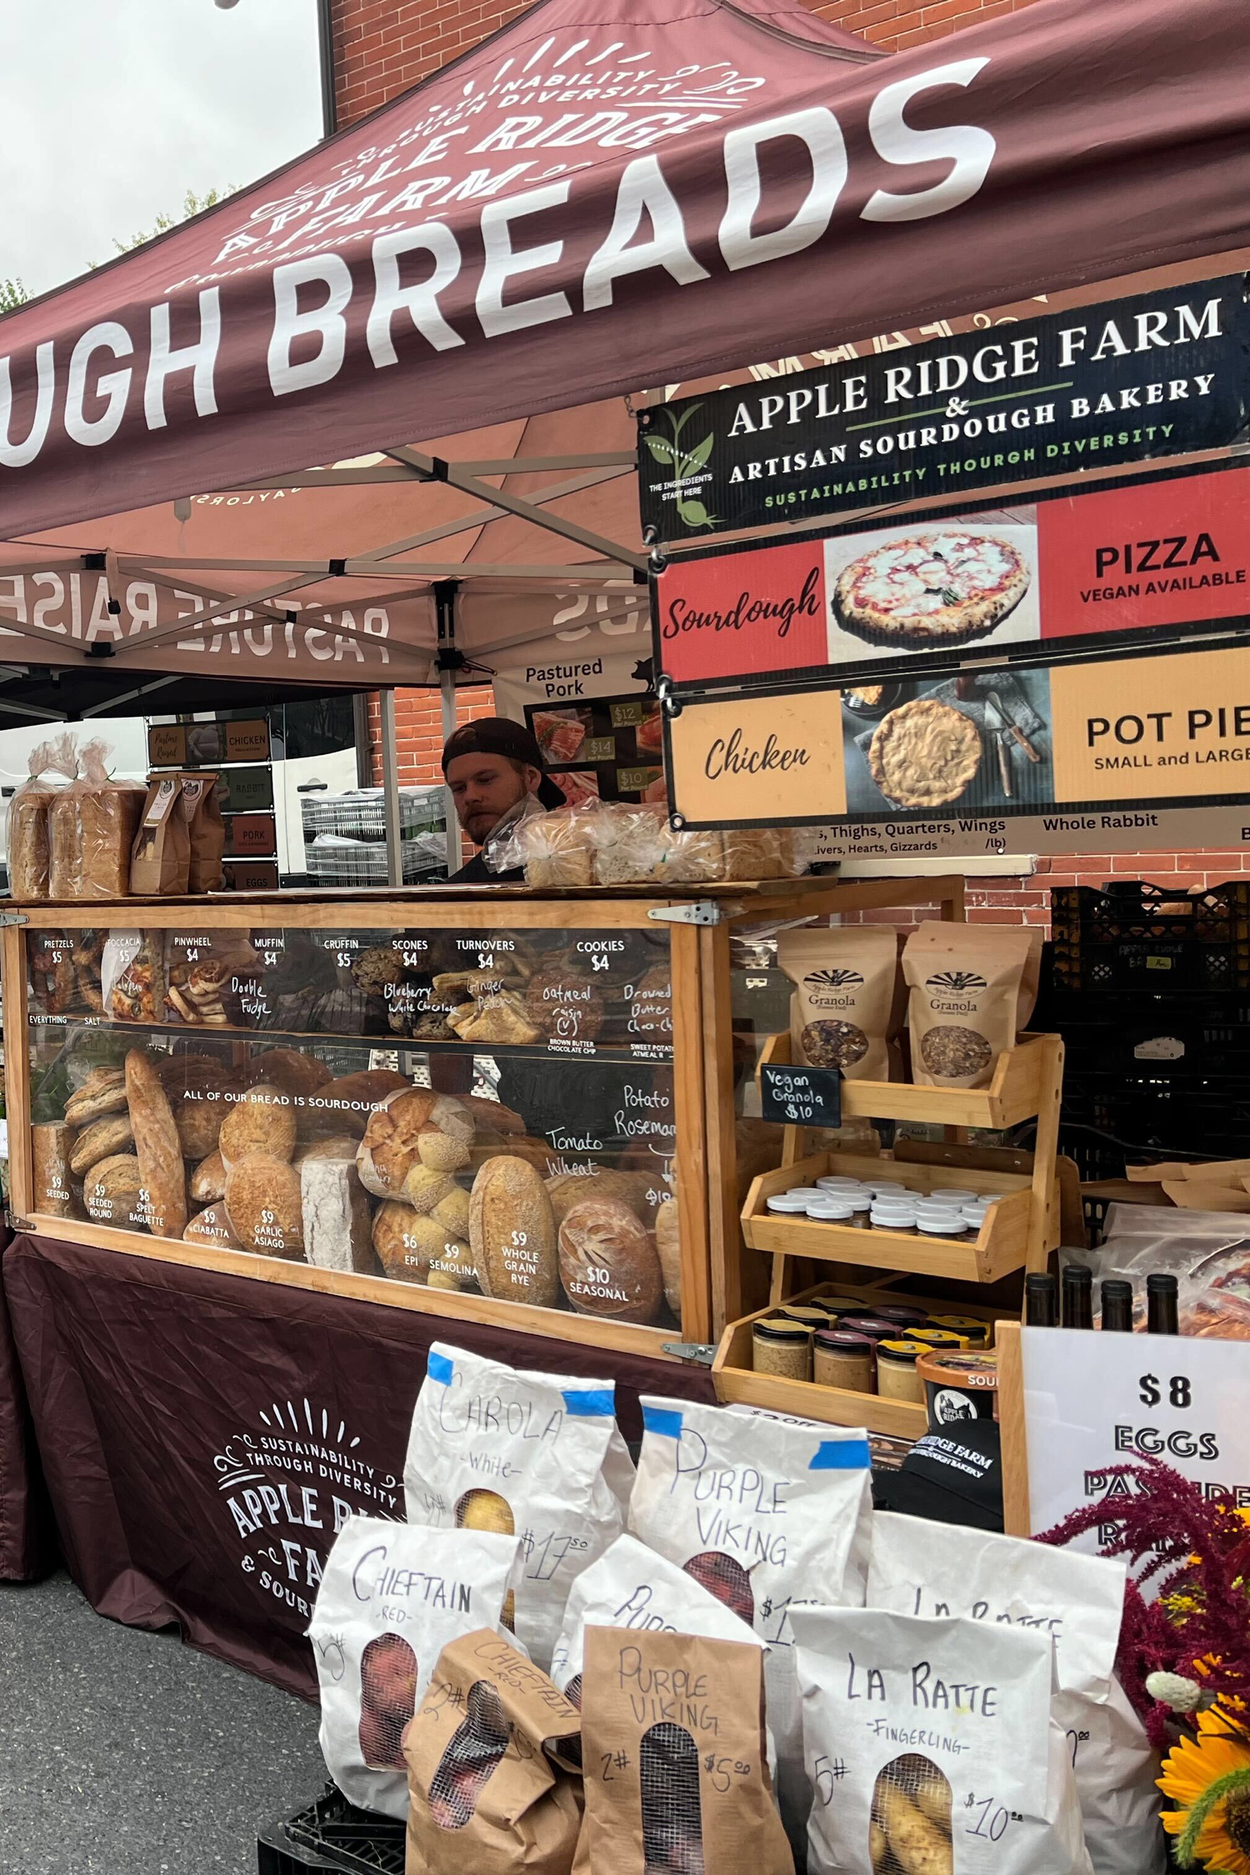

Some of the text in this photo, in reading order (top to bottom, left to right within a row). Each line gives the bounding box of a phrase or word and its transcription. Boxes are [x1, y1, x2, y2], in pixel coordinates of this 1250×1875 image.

[498, 82, 682, 108] DIVERSITY
[211, 126, 470, 266] APPLE
[268, 160, 539, 254] FARM
[266, 56, 997, 396] BREADS
[727, 374, 868, 437] APPLE
[883, 337, 1040, 404] RIDGE
[1057, 297, 1224, 368] FARM
[945, 396, 970, 418] &
[728, 373, 1216, 484] ARTISAN SOURDOUGH BAKERY
[764, 423, 1175, 508] SUSTAINABILITY THOURGH DIVERSITY
[649, 473, 713, 492] THE INGREDIENTS
[661, 486, 702, 501] START HERE
[1095, 532, 1221, 578] PIZZA
[1080, 569, 1246, 603] VEGAN AVAILABLE
[663, 566, 821, 639] Sourdough
[525, 658, 603, 683] Pastured
[545, 679, 584, 698] Pork
[614, 707, 636, 722] $12
[1087, 711, 1173, 747] POT
[229, 735, 266, 746] CHICKEN
[590, 740, 611, 755] $14
[704, 728, 812, 781] Chicken
[1094, 754, 1152, 770] SMALL
[1157, 751, 1189, 767] and
[620, 772, 643, 785] $10
[830, 821, 882, 840] Thighs,
[885, 819, 955, 837] Quarters,
[958, 817, 1006, 835] Wings
[1042, 813, 1159, 832] Whole Rabbit
[242, 830, 265, 839] PORK
[848, 840, 938, 855] Hearts, Gizzards
[246, 878, 268, 887] EGGS
[44, 940, 74, 949] PRETZELS
[174, 937, 212, 947] PINWHEEL
[254, 938, 283, 948] MUFFIN
[324, 940, 359, 949] CRUFFIN
[392, 940, 428, 950] SCONES
[456, 940, 515, 951] TURNOVERS
[576, 940, 625, 951] COOKIES
[52, 951, 62, 963] $5
[119, 949, 130, 962] $5
[186, 948, 199, 962] $4
[264, 951, 277, 965] $4
[337, 952, 351, 968] $5
[402, 952, 418, 967] $4
[478, 953, 494, 969] $4
[591, 954, 609, 971] $4
[467, 975, 505, 994] Ginger
[623, 983, 672, 1000] Browned
[389, 999, 415, 1013] White
[808, 994, 856, 1006] Granola
[930, 999, 978, 1013] Granola
[241, 998, 271, 1019] Fudge
[631, 1003, 670, 1018] Butter
[29, 1015, 67, 1025] EVERYTHING
[84, 1016, 100, 1026] SALT
[547, 1045, 580, 1053] CHOCOLATE
[575, 1040, 594, 1048] BUTTER
[766, 1069, 810, 1093] Vegan
[183, 1090, 389, 1113] ALL OF OUR BREAD IS SOURDOUGH
[623, 1084, 670, 1109] Potato
[771, 1088, 825, 1107] Granola
[784, 1104, 814, 1121] $10
[545, 1126, 603, 1151] Tomato
[546, 1157, 600, 1178] Wheat
[51, 1175, 62, 1189] $9
[94, 1183, 106, 1197] $9
[46, 1188, 70, 1200] SEEDED
[138, 1188, 150, 1202] $6
[88, 1196, 113, 1209] SEEDED
[135, 1201, 156, 1215] SPELT
[88, 1207, 112, 1219] ROUND
[128, 1211, 164, 1227] BAGUETTE
[203, 1210, 216, 1224] $9
[261, 1210, 275, 1224] $9
[192, 1223, 230, 1239] CIABATTA
[253, 1224, 283, 1238] GARLIC
[511, 1230, 528, 1246] $9
[253, 1235, 285, 1250] ASIAGO
[402, 1232, 418, 1250] $6
[444, 1243, 460, 1259] $9
[501, 1246, 539, 1264] WHOLE
[404, 1254, 419, 1267] EPI
[429, 1258, 480, 1277] SEMOLINA
[504, 1260, 537, 1275] GRAIN
[511, 1274, 530, 1287] RYE
[587, 1267, 610, 1285] $10
[569, 1281, 630, 1302] SEASONAL
[1114, 1424, 1219, 1461] EGGS
[261, 1436, 374, 1480] SUSTAINABILITY
[954, 1444, 993, 1470] FARM
[670, 1427, 792, 1514] PURPLE
[245, 1452, 397, 1509] THROUGH DIVERSITY
[226, 1483, 324, 1539] APPLE
[696, 1506, 787, 1568] VIKING
[240, 1554, 256, 1573] &
[352, 1545, 471, 1614] CHIEFTAIN
[473, 1641, 581, 1719] CHIEFTAIN
[619, 1646, 707, 1699] PURPLE
[847, 1652, 998, 1717] LA RATTE
[630, 1693, 718, 1736] VIKING
